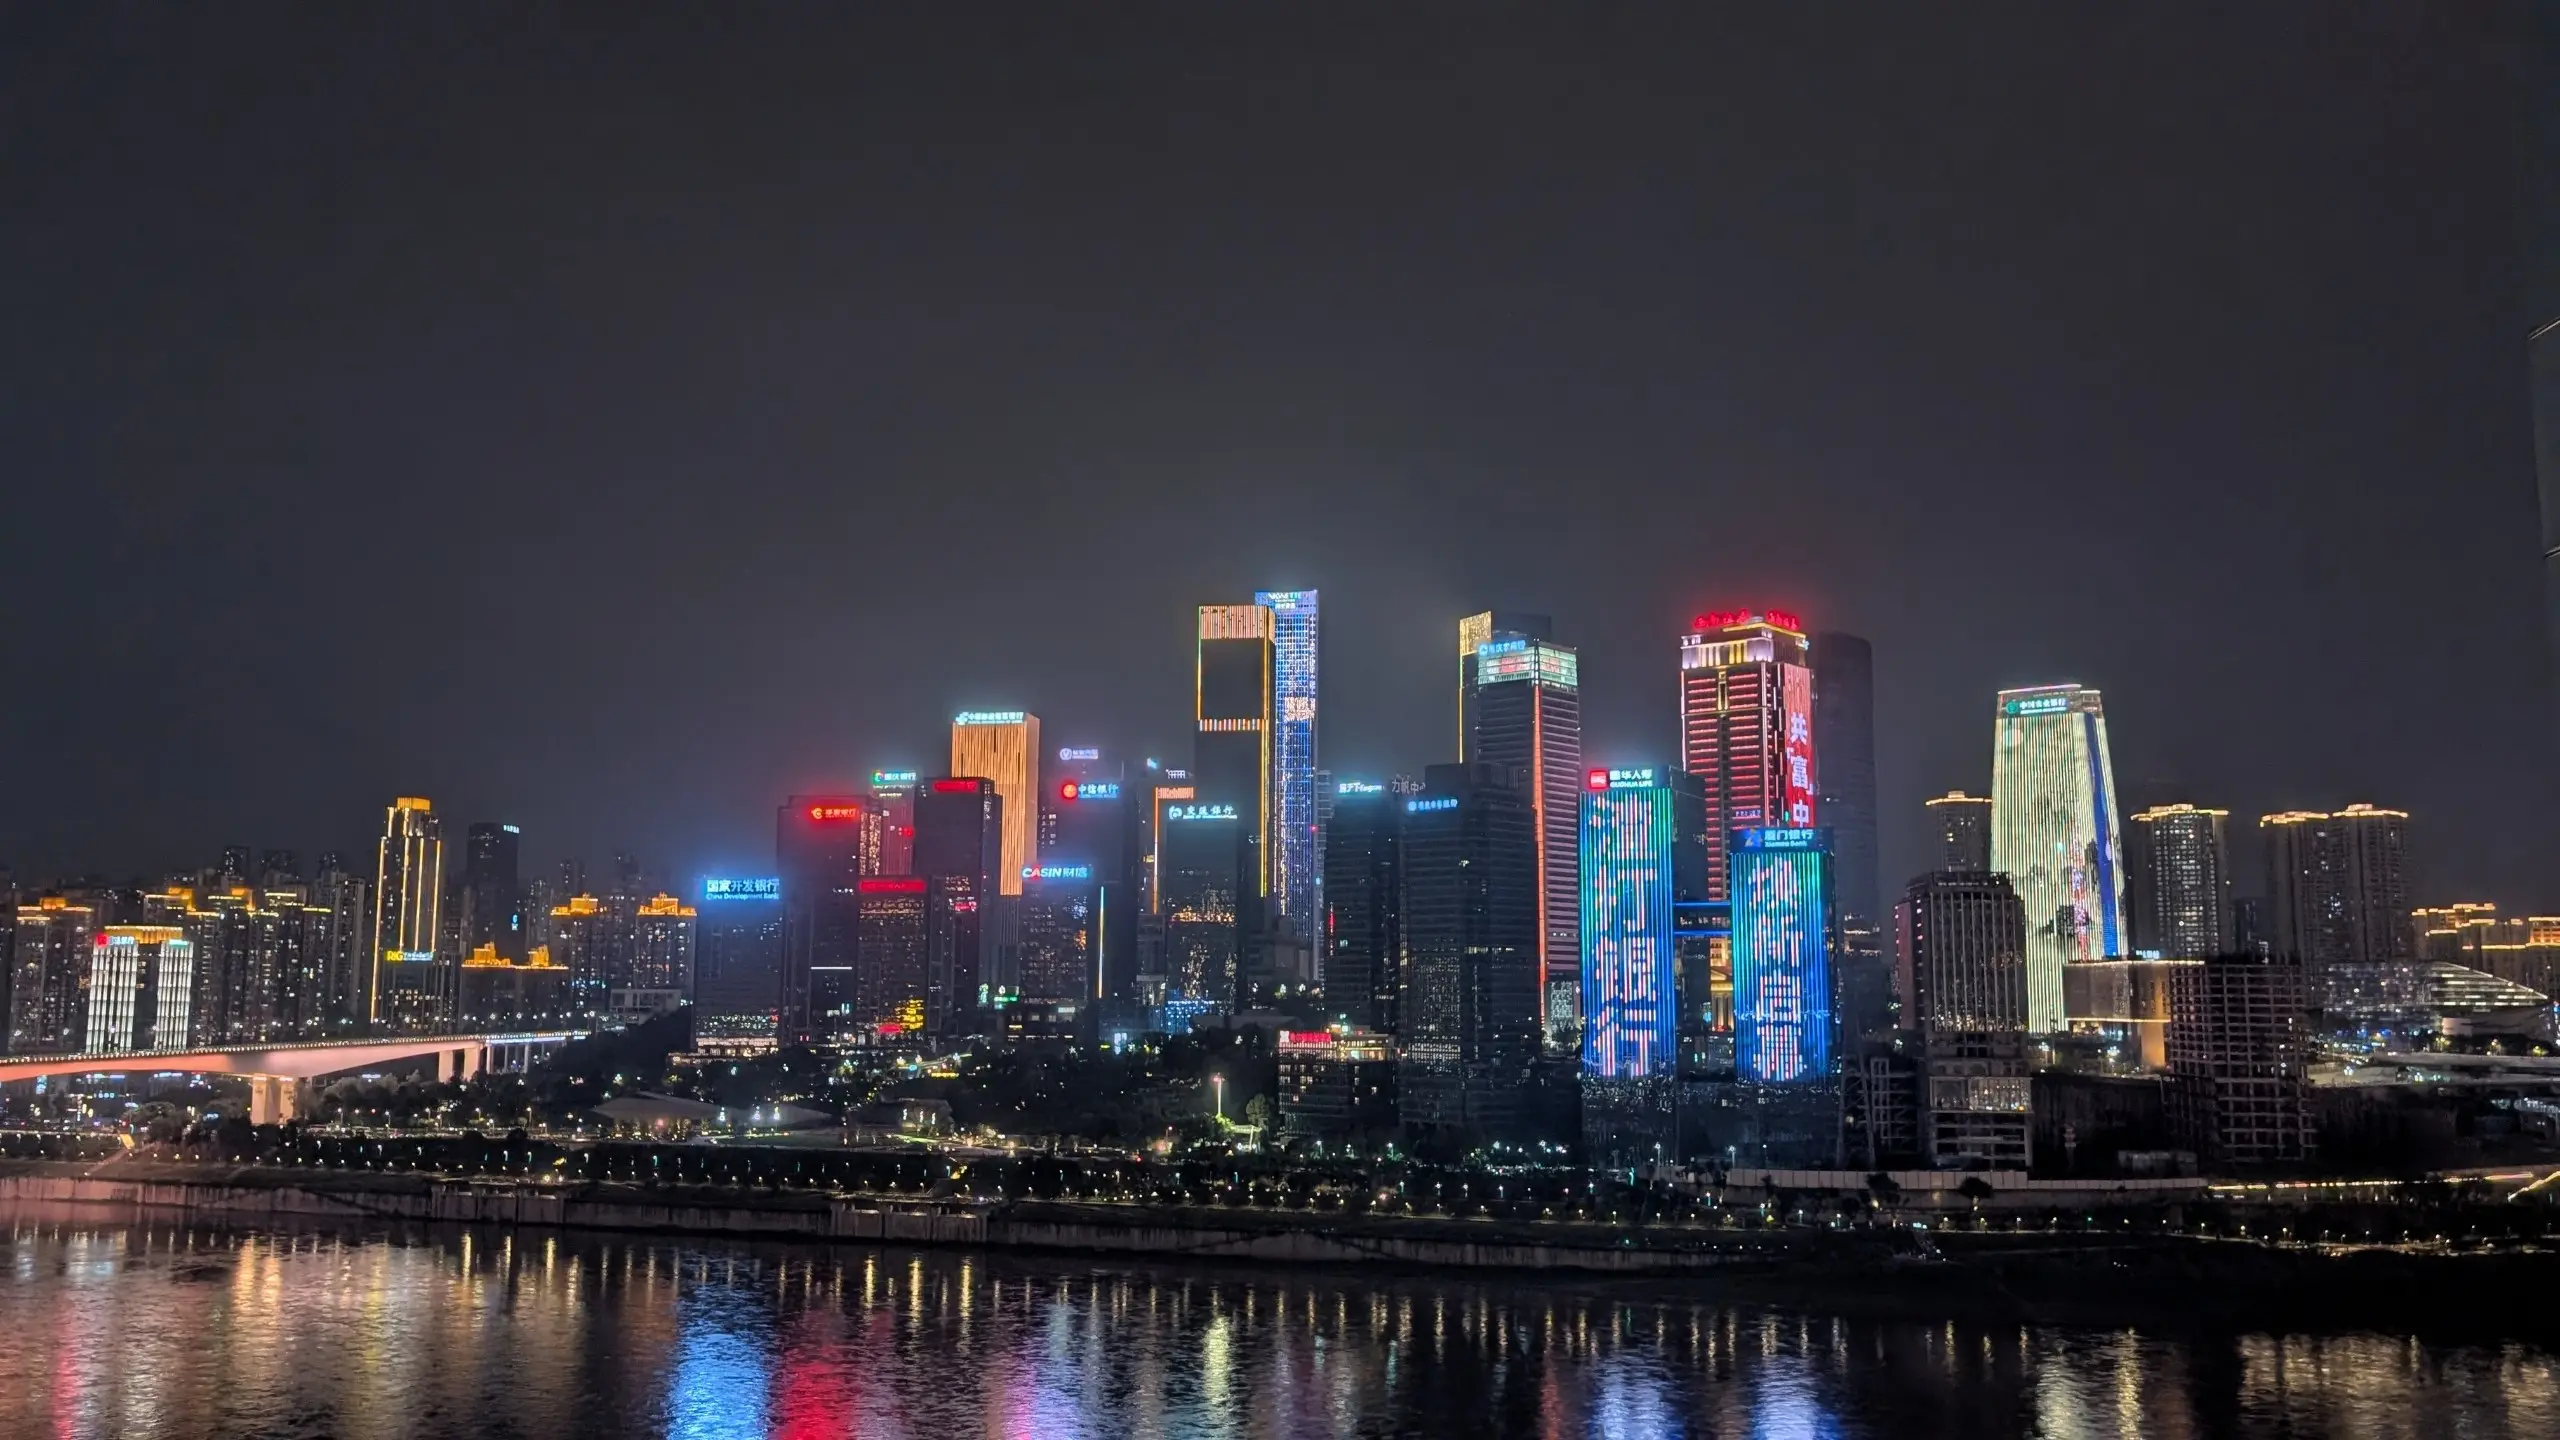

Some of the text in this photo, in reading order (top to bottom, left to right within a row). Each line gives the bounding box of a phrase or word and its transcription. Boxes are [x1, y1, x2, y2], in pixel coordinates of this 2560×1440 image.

[1764, 829, 1814, 841] 厦门银行
[1022, 867, 1088, 879] CASIN 财信
[707, 879, 780, 892] 国家开发银行
[705, 892, 723, 900] China
[763, 892, 780, 900] Bank
